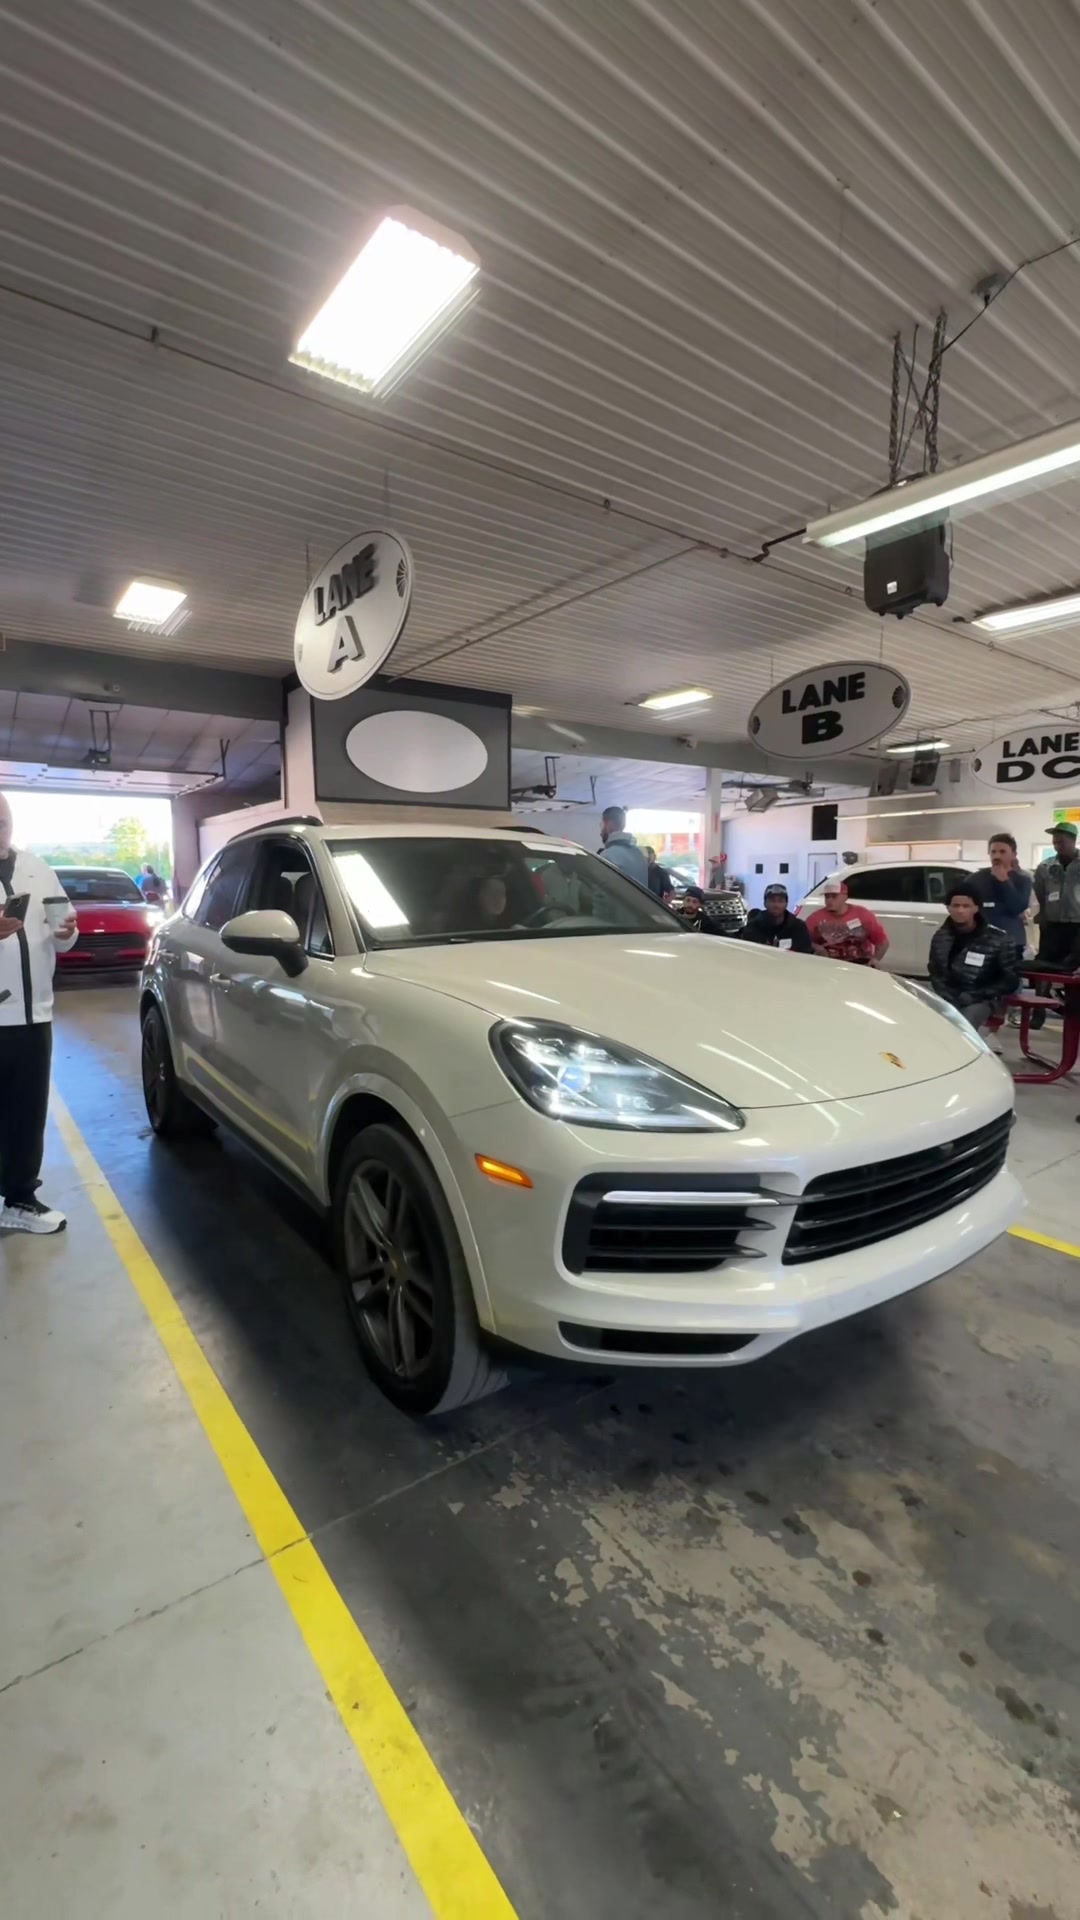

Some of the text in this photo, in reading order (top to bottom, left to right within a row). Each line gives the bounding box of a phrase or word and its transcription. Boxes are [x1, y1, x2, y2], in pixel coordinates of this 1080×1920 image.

[314, 543, 379, 626] LANE
[327, 615, 366, 674] A
[782, 672, 865, 714] LANE
[802, 710, 844, 744] B
[1003, 732, 1079, 758] LANE
